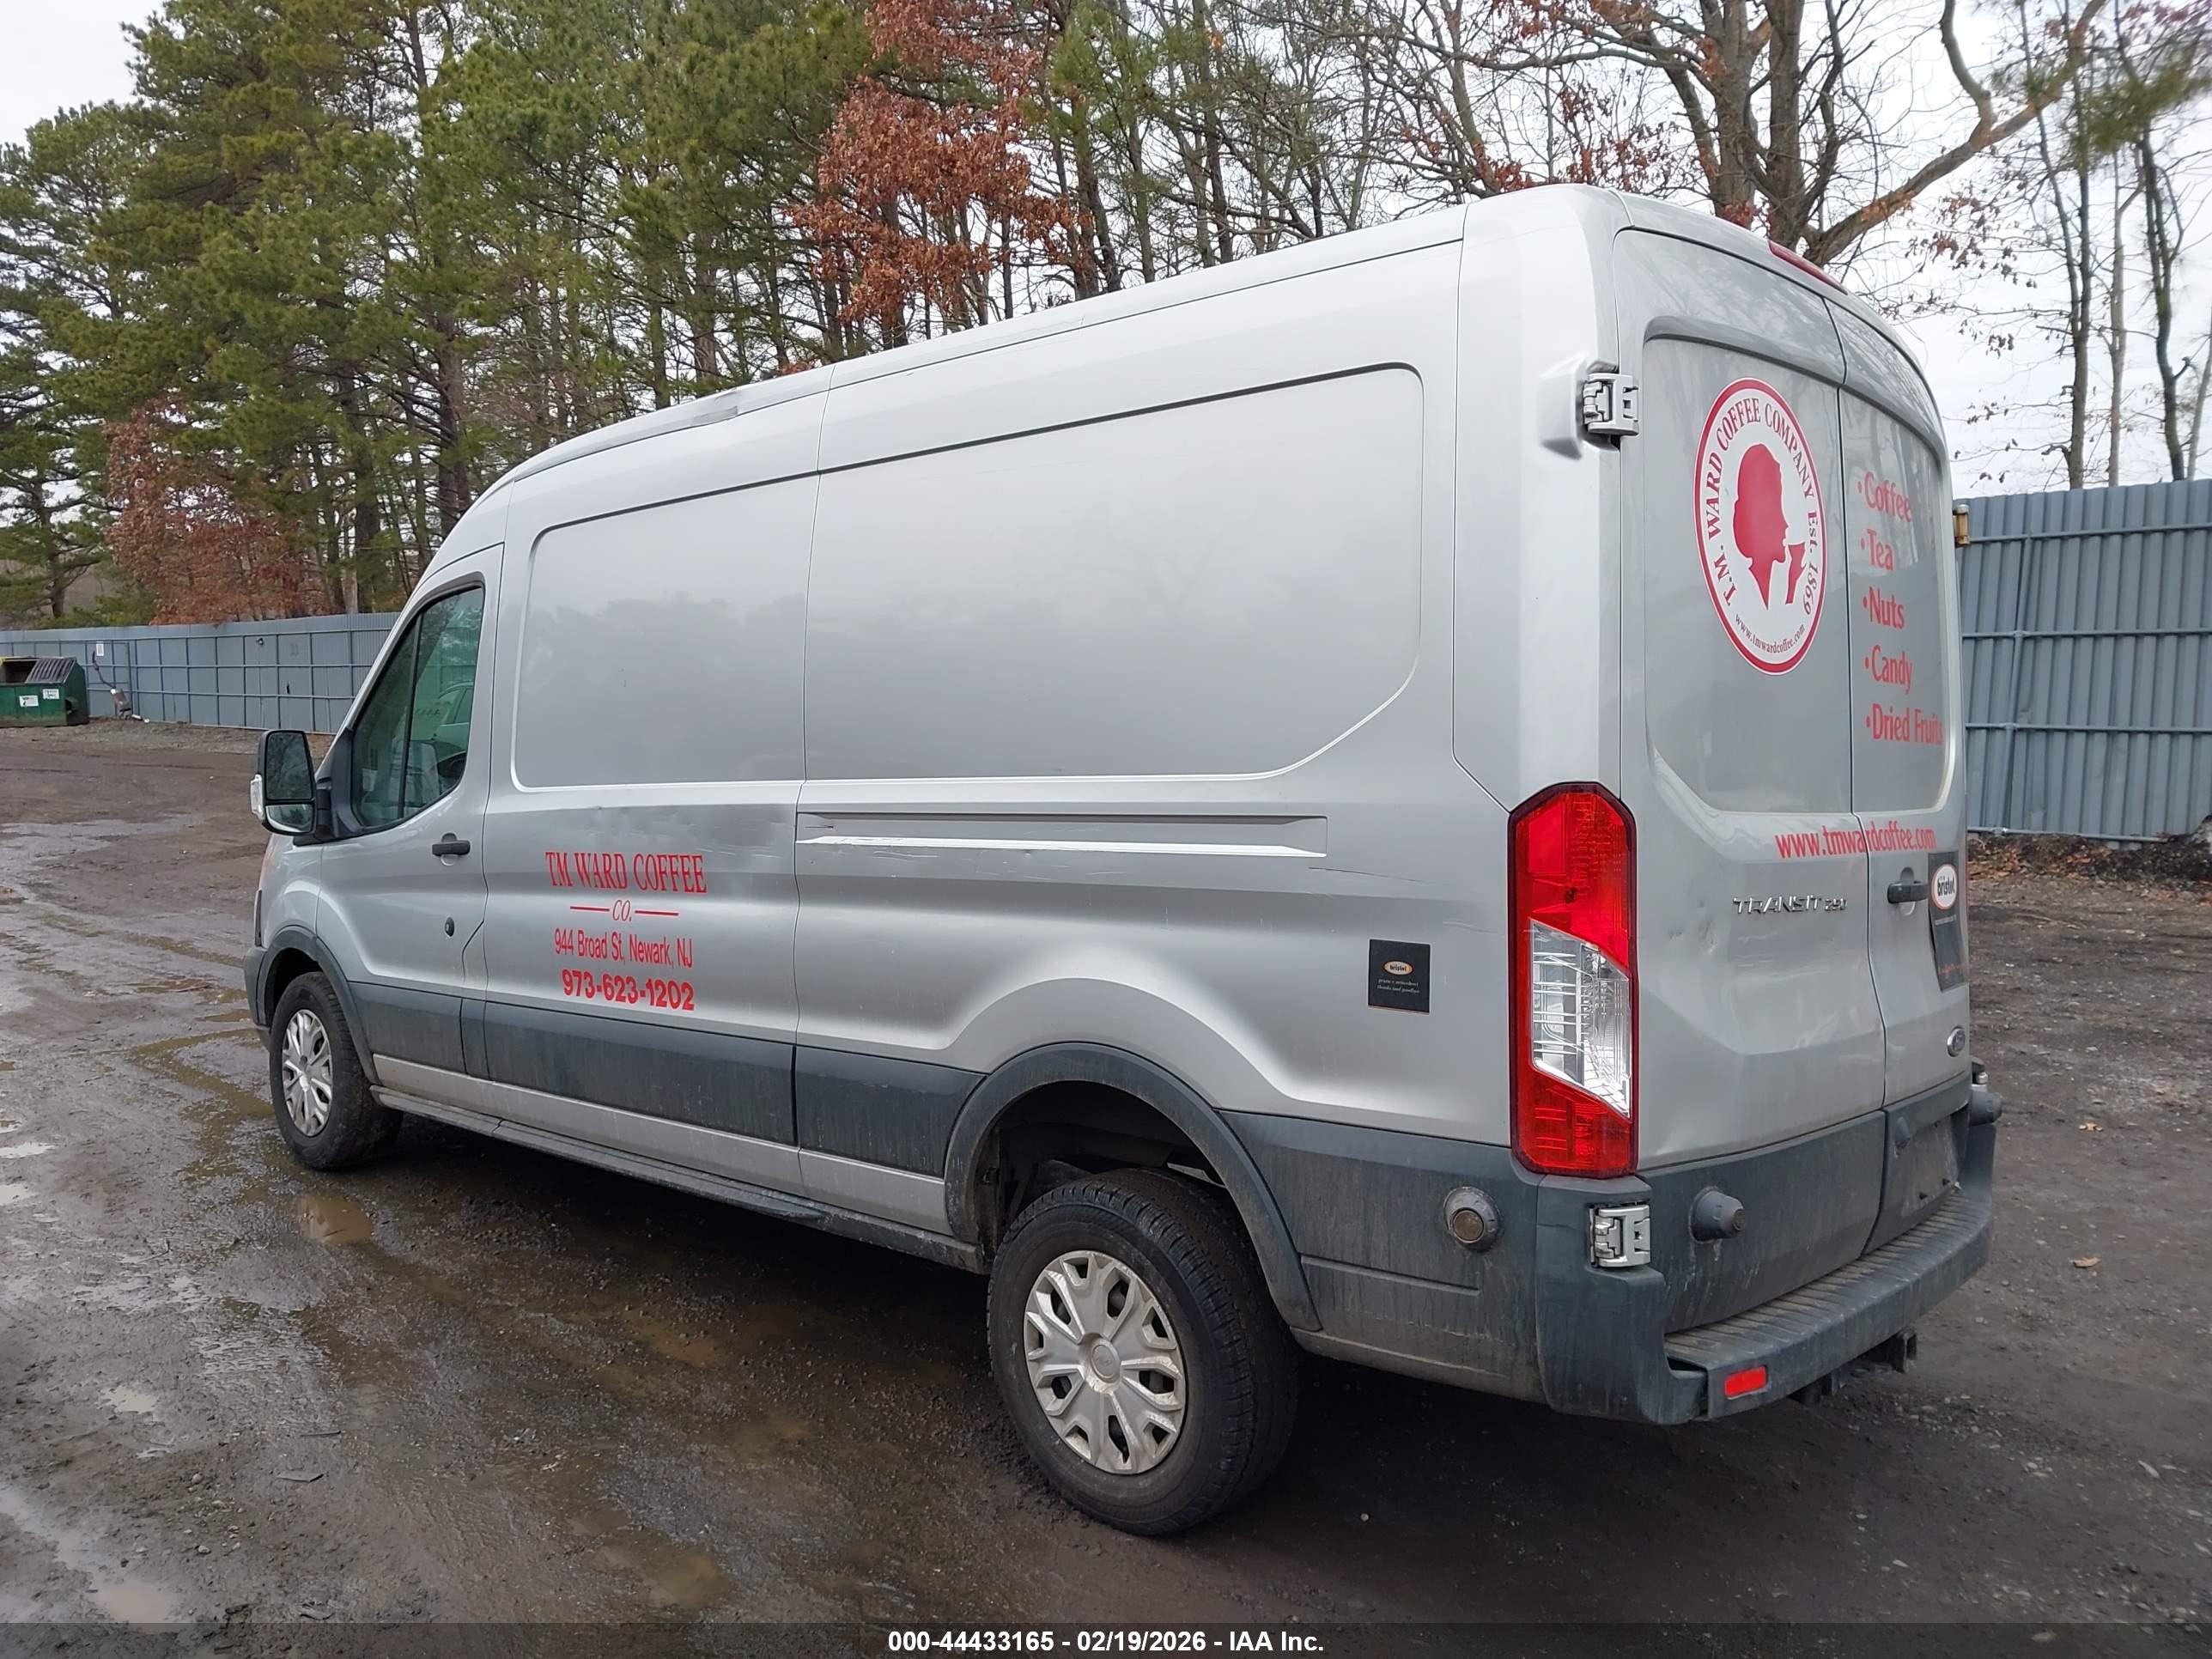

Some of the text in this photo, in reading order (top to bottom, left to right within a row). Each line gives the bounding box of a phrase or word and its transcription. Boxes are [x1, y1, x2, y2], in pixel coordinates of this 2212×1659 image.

[1705, 451, 1723, 541] WARD
[1717, 397, 1761, 452] COFFEE
[1765, 403, 1815, 498] COMPANY
[1802, 562, 1819, 616] 1869
[1863, 471, 1912, 523] Coffee
[1866, 528, 1893, 572] Tea
[1869, 586, 1905, 629] Nuts
[1735, 613, 1806, 654] www.tmwardcoffee.com
[1871, 645, 1913, 695] Candy
[1872, 703, 1943, 745] Dried Fruits
[1774, 821, 1937, 858] www.tmwardcoffee.com
[544, 851, 708, 894] TM WARD COFFEE
[611, 898, 632, 922] CO.
[1733, 894, 1822, 914] TRANSIT
[554, 927, 574, 956] 944
[577, 929, 608, 960] Broad
[629, 933, 674, 969] Newark,
[677, 938, 694, 969] NJ
[561, 968, 695, 1012] 973-623-1202
